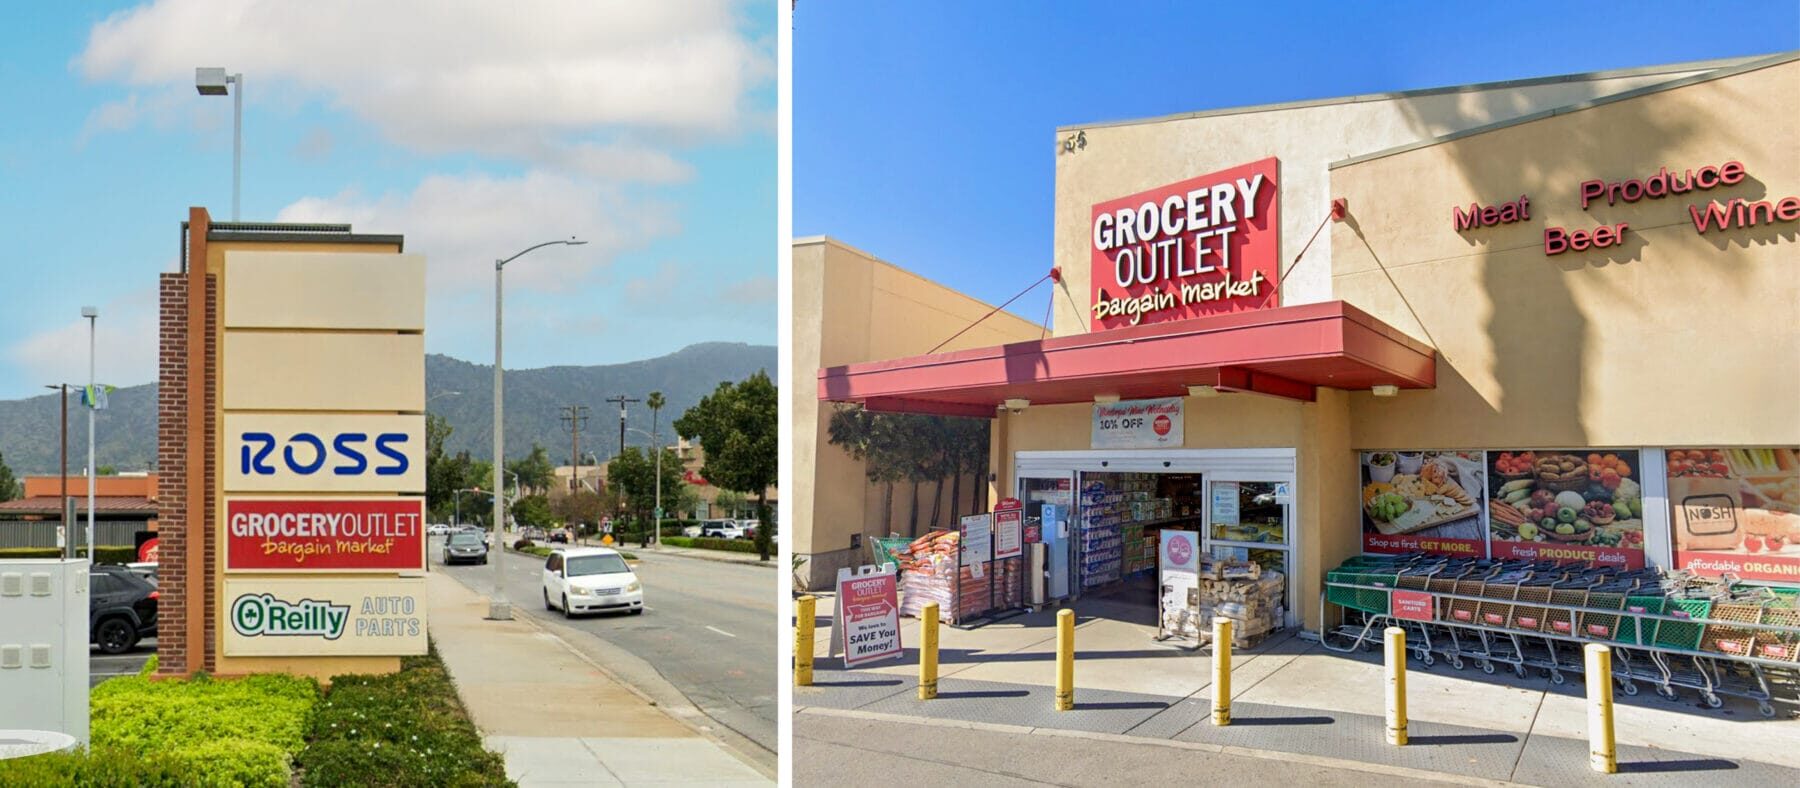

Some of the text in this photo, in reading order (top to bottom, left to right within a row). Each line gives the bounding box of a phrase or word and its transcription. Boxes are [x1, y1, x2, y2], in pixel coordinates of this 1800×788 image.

[1453, 160, 1745, 232] Meat Produce
[1093, 173, 1264, 251] GROCERY
[1544, 196, 1800, 256] Beer Wine
[1115, 226, 1236, 288] OUTLET
[1091, 269, 1264, 326] bargain market
[1100, 419, 1118, 430] 10%
[1122, 418, 1144, 429] OFF
[241, 432, 409, 475] ROSS
[261, 537, 393, 562] bargain market
[1368, 537, 1388, 549] Shop
[1420, 540, 1440, 550] GET
[1441, 542, 1474, 553] MORE.
[1511, 545, 1626, 563] fresh PRODUCE deals
[1686, 558, 1800, 575] affordable ORGANI
[851, 578, 887, 591] GROCERY
[856, 586, 882, 597] OUTLET
[361, 596, 415, 615] AUTO
[237, 597, 344, 635] O'Reilly
[355, 617, 420, 637] PARTS
[849, 629, 896, 645] SAVE You
[857, 639, 892, 655] Money!
